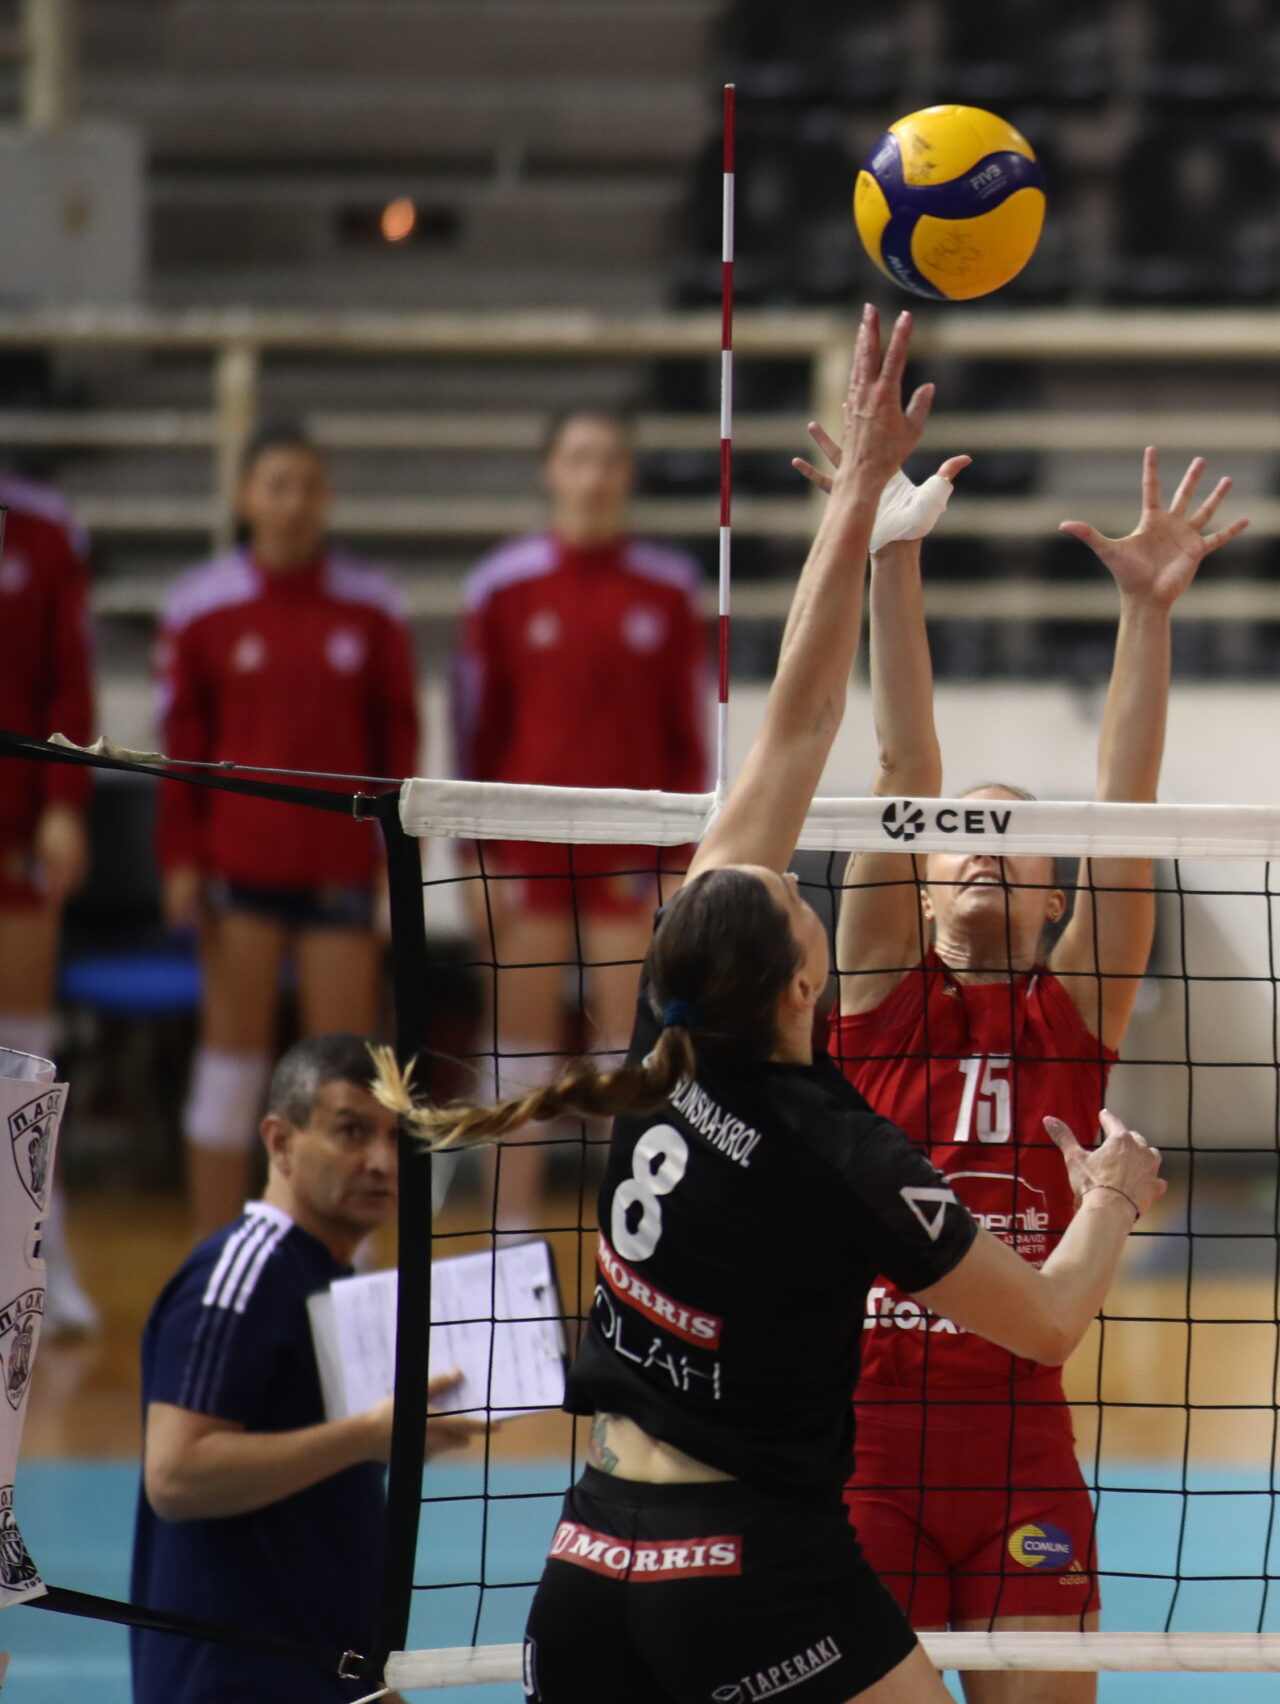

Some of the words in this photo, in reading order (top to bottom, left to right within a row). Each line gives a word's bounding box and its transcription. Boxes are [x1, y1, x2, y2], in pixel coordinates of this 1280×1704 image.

[935, 808, 1012, 834] CEV
[953, 1052, 1011, 1143] 15
[611, 1124, 689, 1262] 8
[599, 1236, 717, 1340] MORRIS
[568, 1533, 737, 1573] MORRIS
[1024, 1540, 1070, 1554] COMLINE
[741, 1635, 840, 1697] TAPERAKI
